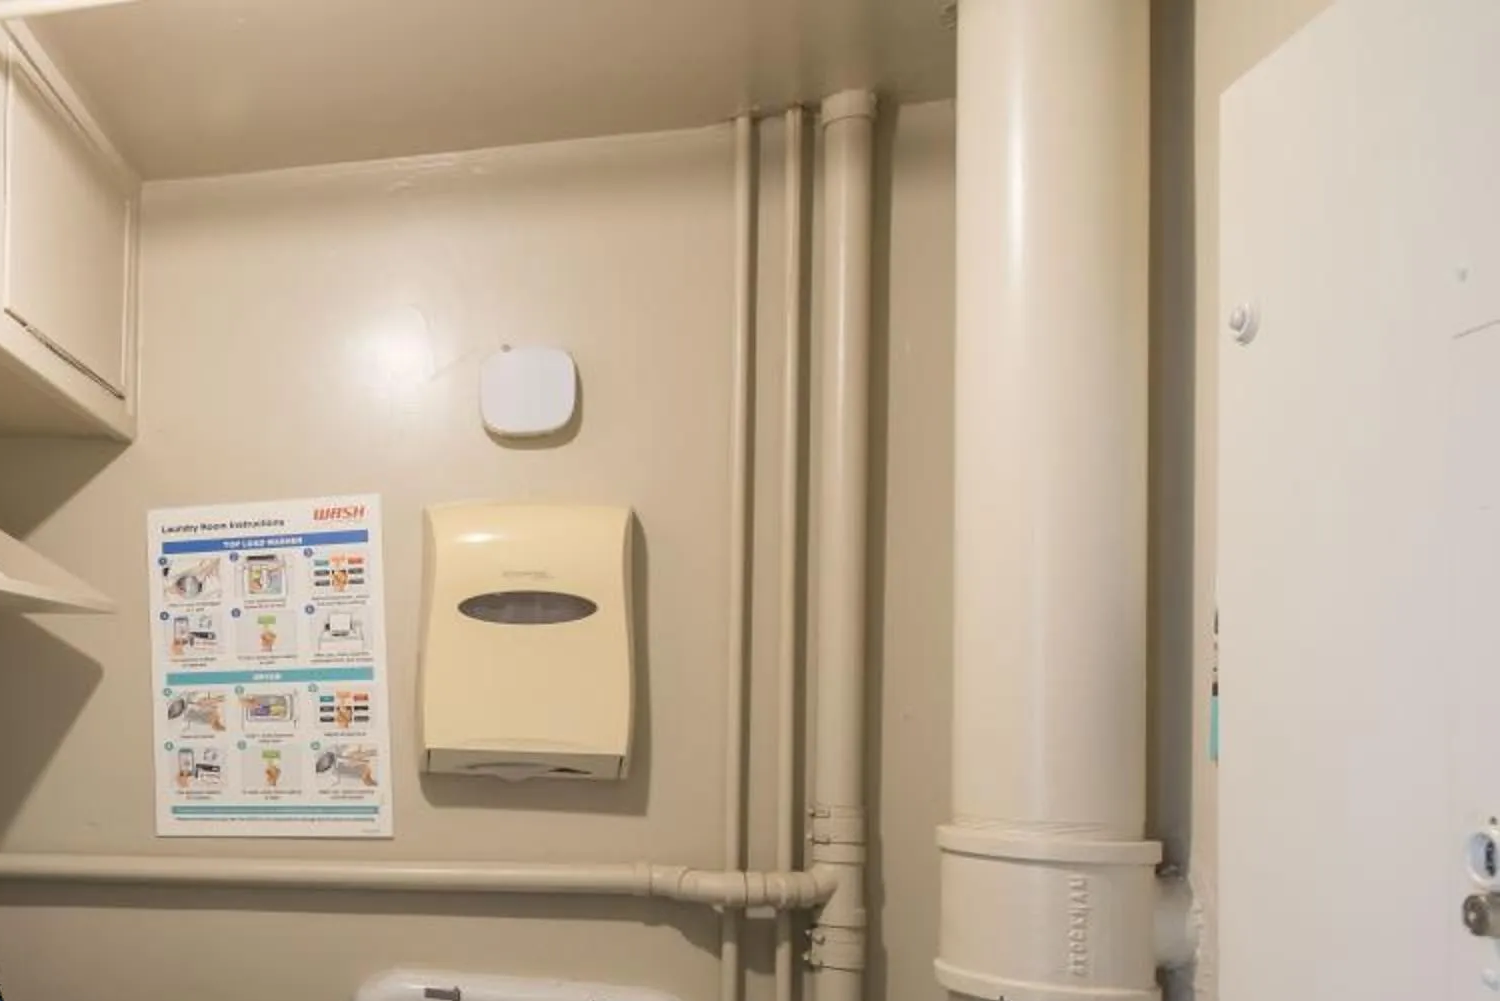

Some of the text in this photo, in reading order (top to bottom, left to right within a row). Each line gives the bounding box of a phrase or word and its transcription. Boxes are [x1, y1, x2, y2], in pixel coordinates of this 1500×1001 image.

[161, 505, 366, 534] Laundry Room Instructions WASH
[222, 540, 240, 549] TOP
